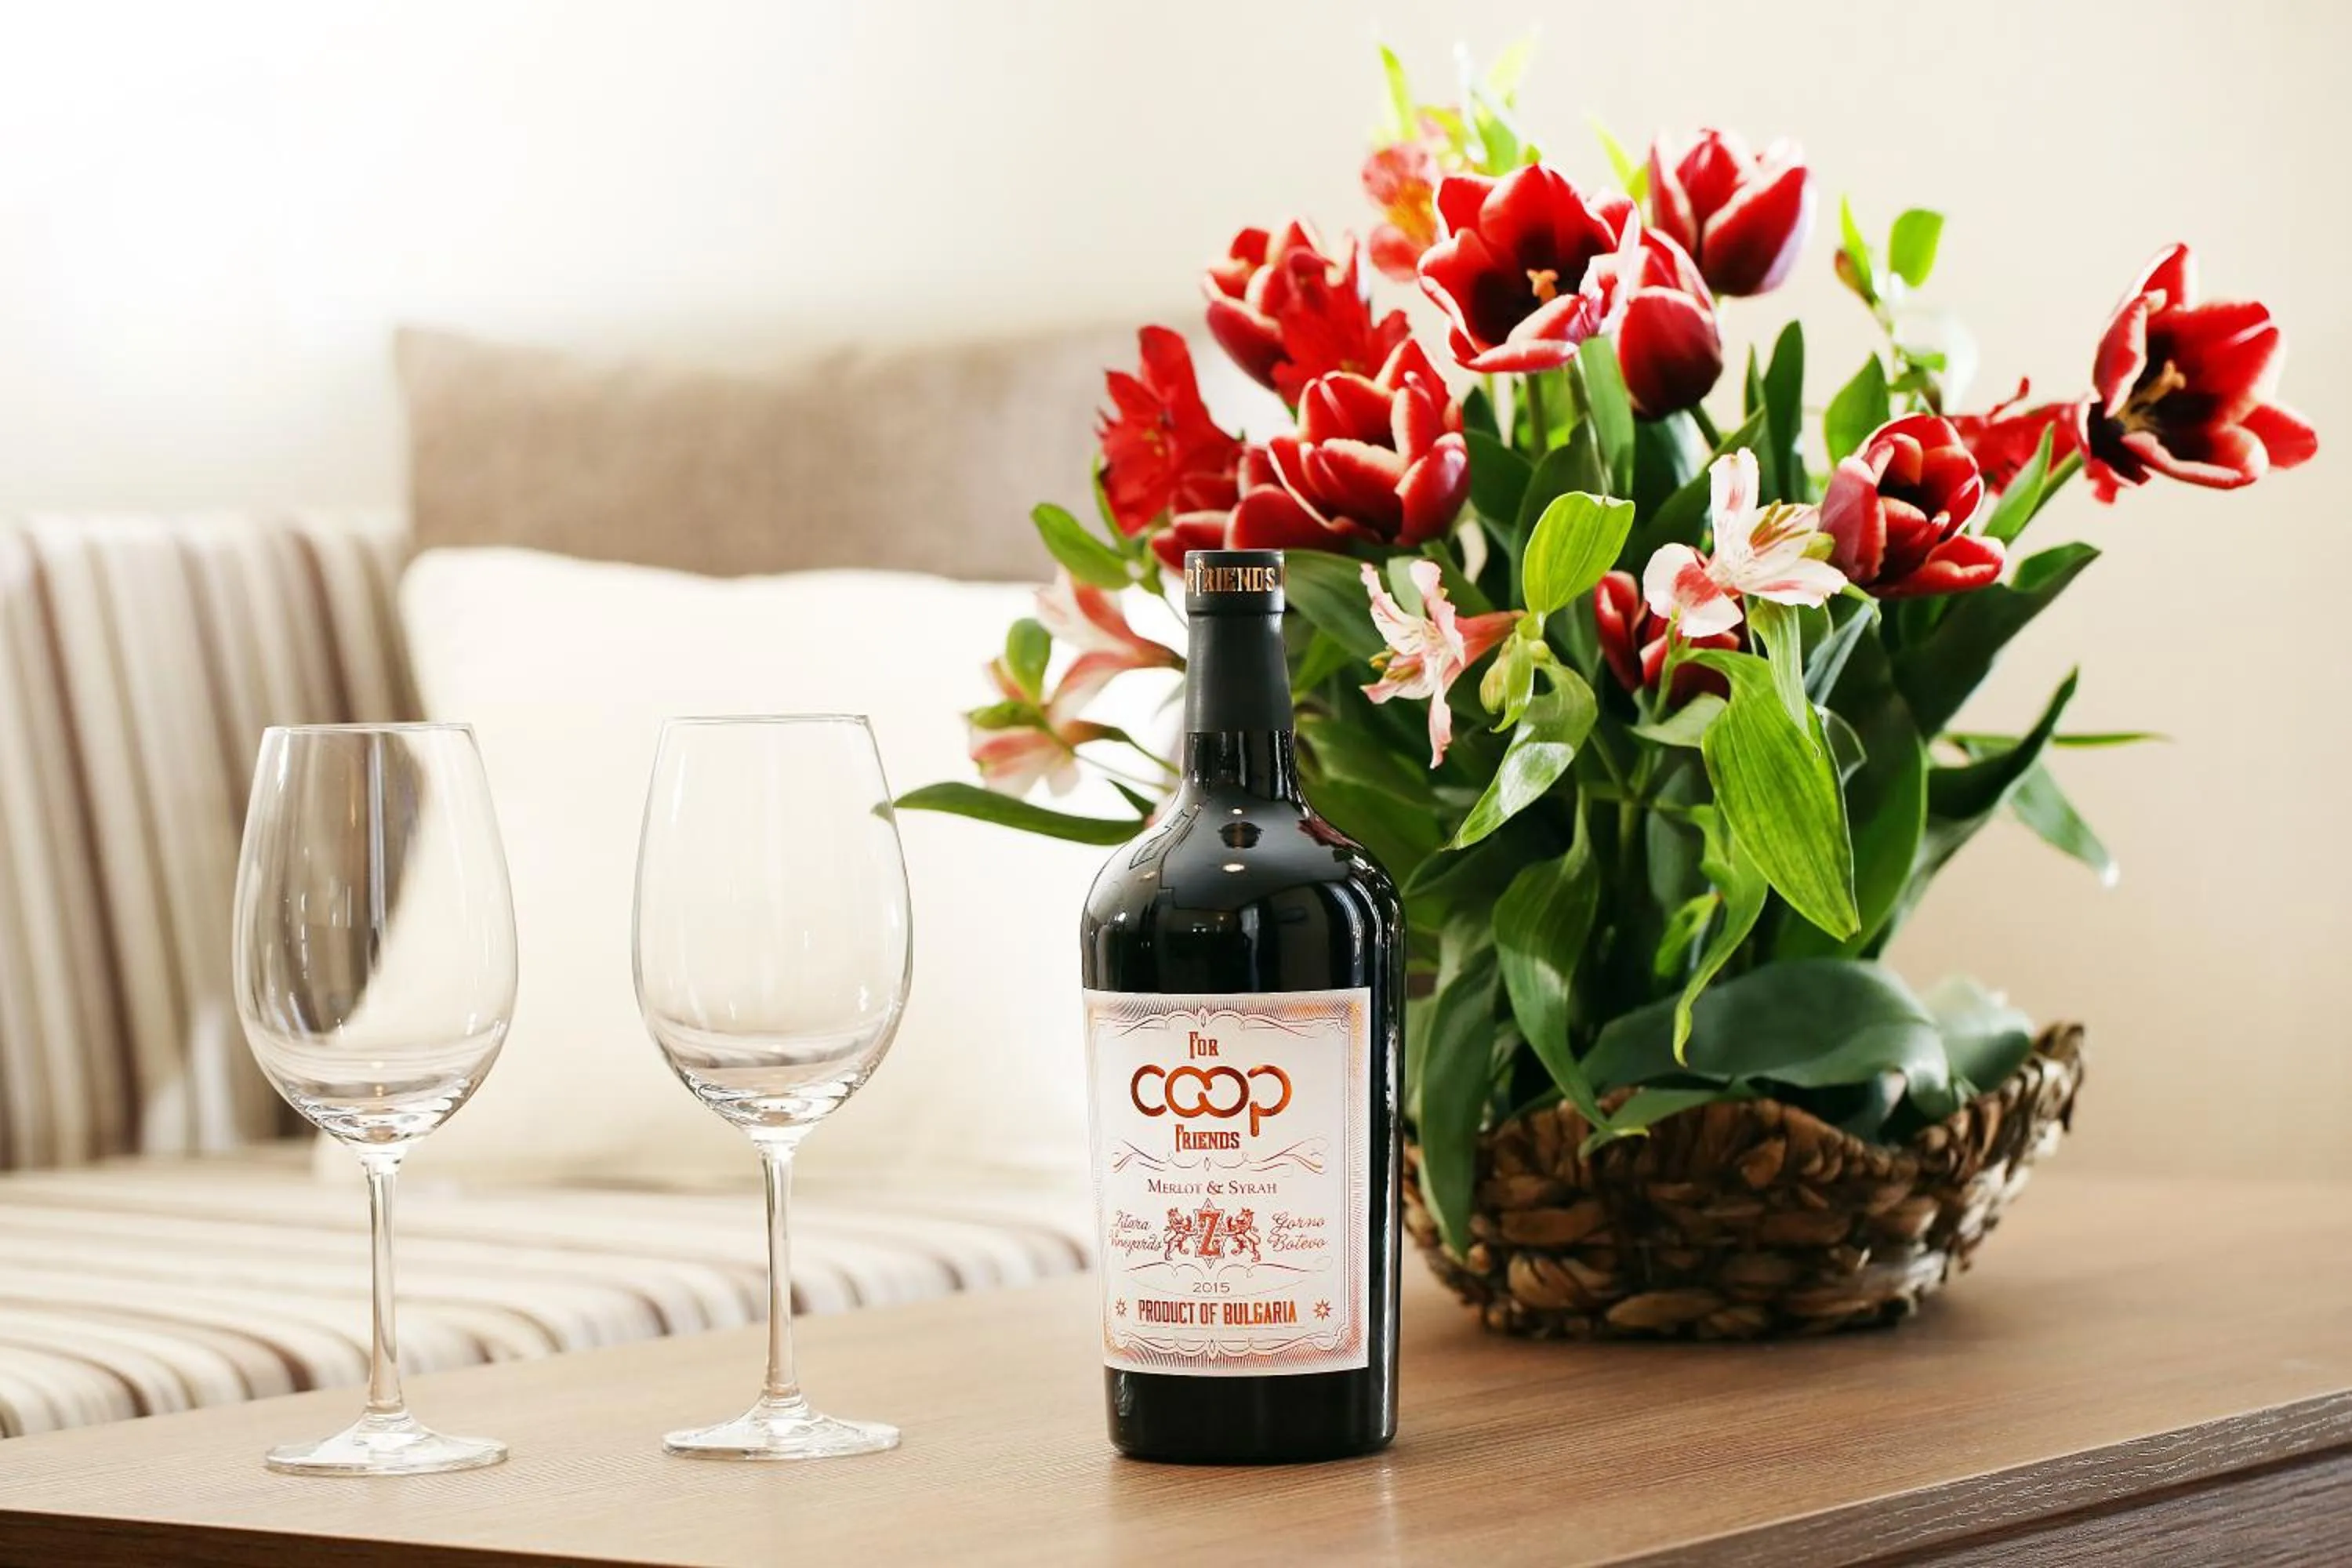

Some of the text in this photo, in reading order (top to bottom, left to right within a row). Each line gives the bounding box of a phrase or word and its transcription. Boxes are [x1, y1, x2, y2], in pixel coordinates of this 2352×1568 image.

[1194, 556, 1276, 597] FRIENDS
[1188, 1031, 1219, 1059] FOR
[1131, 1064, 1293, 1137] coop
[1174, 1123, 1240, 1152] FRIENDS
[1148, 1178, 1277, 1195] MERLOT & SYRAH
[1192, 1281, 1231, 1294] 2015
[1138, 1299, 1298, 1326] PRODUCT OF BULGARIA
